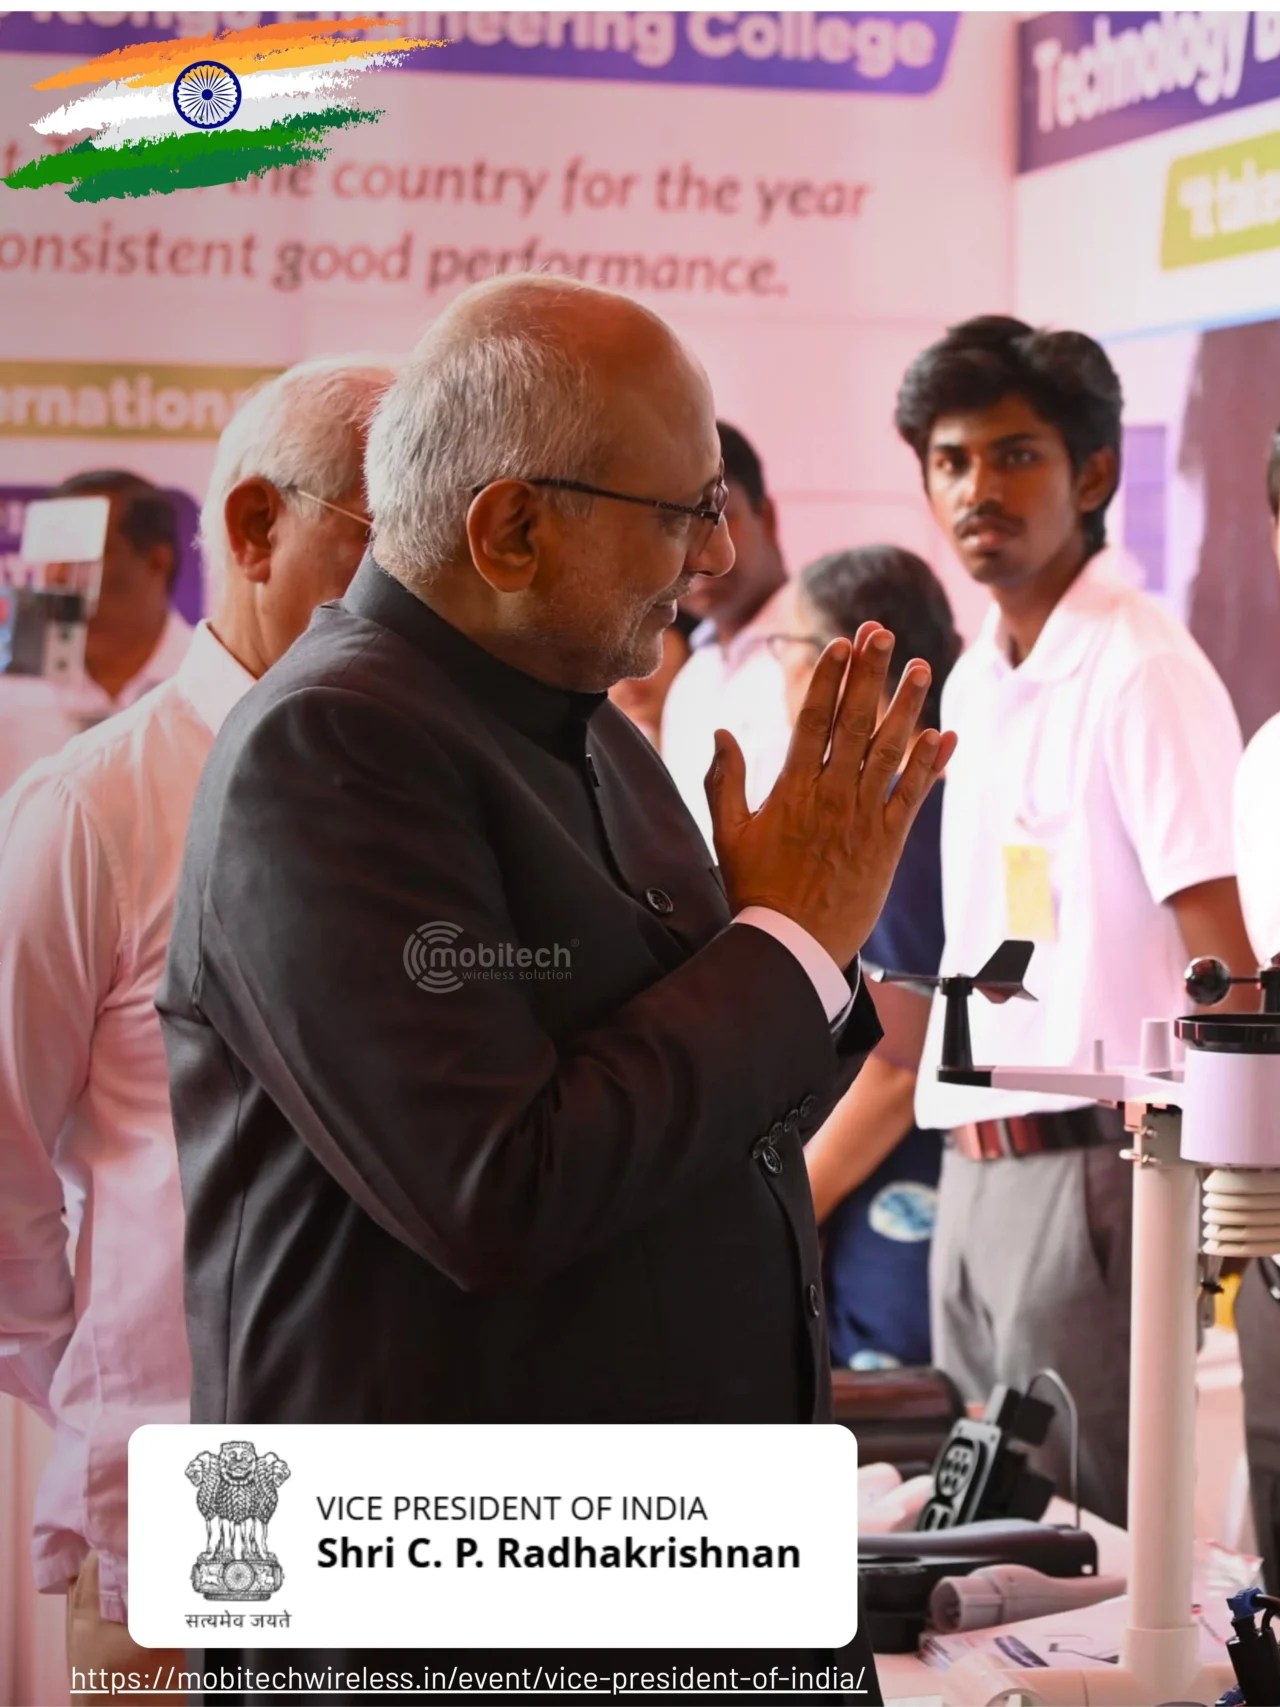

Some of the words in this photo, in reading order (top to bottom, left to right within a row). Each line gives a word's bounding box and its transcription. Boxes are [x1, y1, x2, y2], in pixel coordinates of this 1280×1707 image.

[686, 11, 936, 79] College
[1033, 11, 1249, 134] Technology
[331, 156, 548, 219] country
[561, 151, 639, 216] for
[655, 158, 743, 215] the
[755, 177, 875, 227] year
[270, 230, 415, 293] good
[426, 234, 790, 298] performance.
[0, 373, 254, 431] rnation
